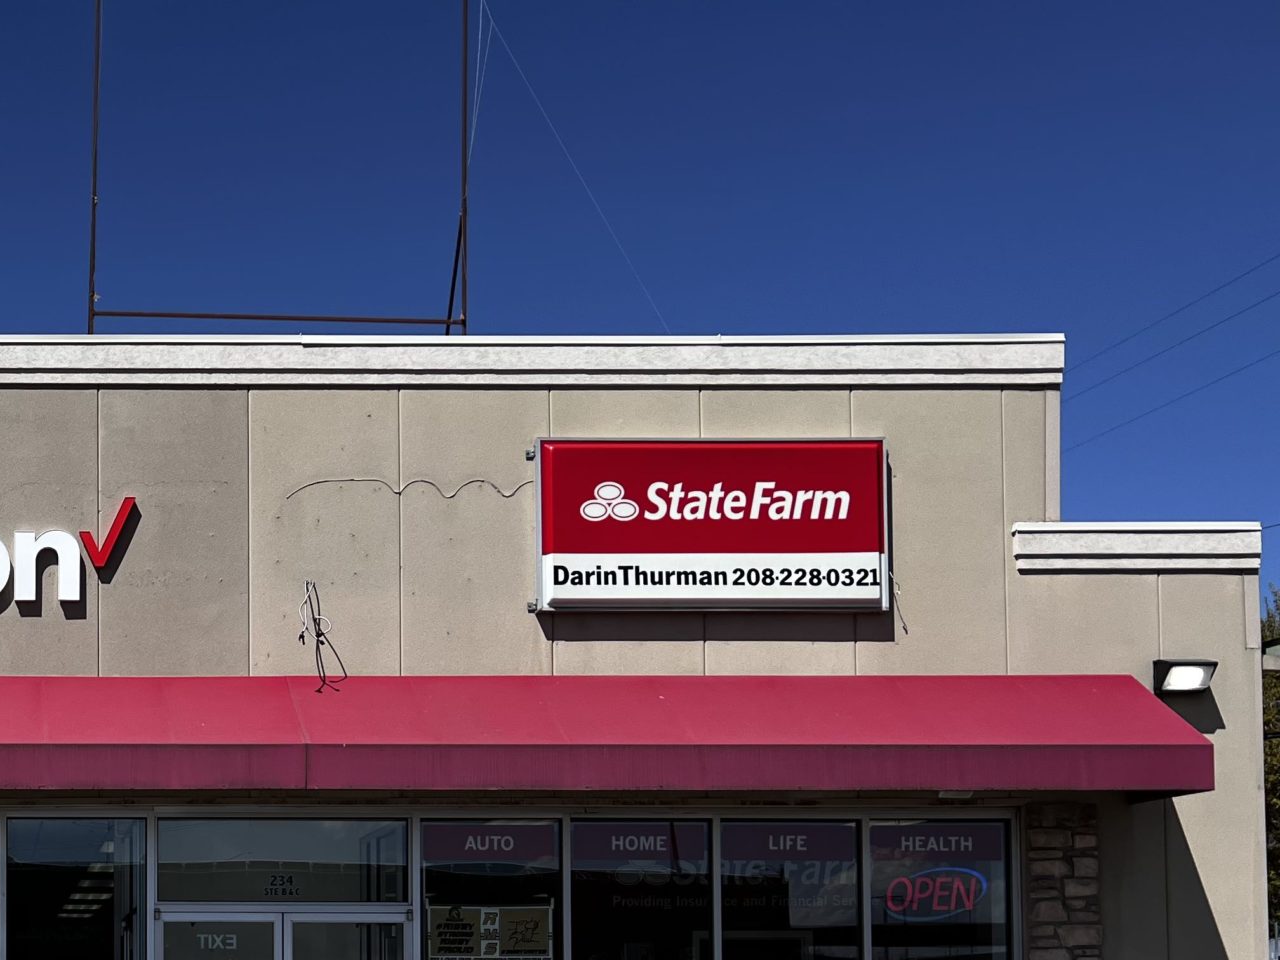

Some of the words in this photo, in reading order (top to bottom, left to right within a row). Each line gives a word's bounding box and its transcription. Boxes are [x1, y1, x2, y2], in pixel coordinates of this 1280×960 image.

[464, 835, 514, 850] AUTO
[611, 835, 667, 851] HOME
[768, 835, 808, 851] LIFE
[900, 836, 973, 852] HEALTH
[270, 875, 293, 886] 234
[264, 887, 280, 896] STE
[885, 875, 977, 912] OPEN
[612, 894, 673, 910] Providing
